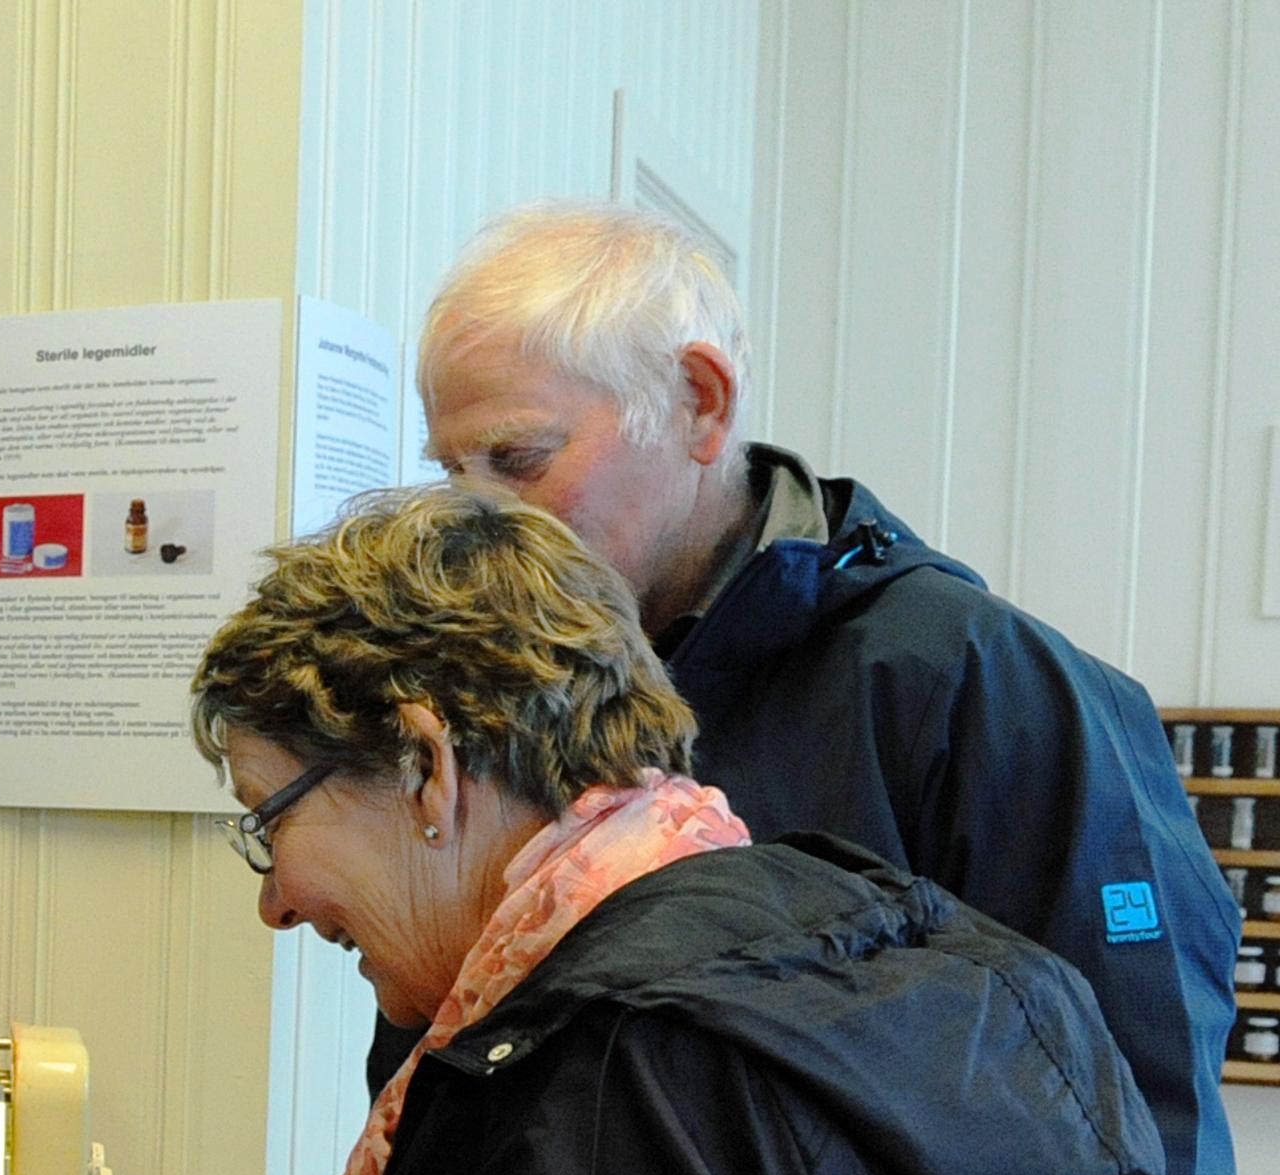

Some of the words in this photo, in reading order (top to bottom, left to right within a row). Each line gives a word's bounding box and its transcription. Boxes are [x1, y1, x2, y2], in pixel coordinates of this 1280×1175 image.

[36, 349, 79, 363] Sterile
[82, 344, 157, 362] legemidler
[1108, 888, 1153, 927] 24
